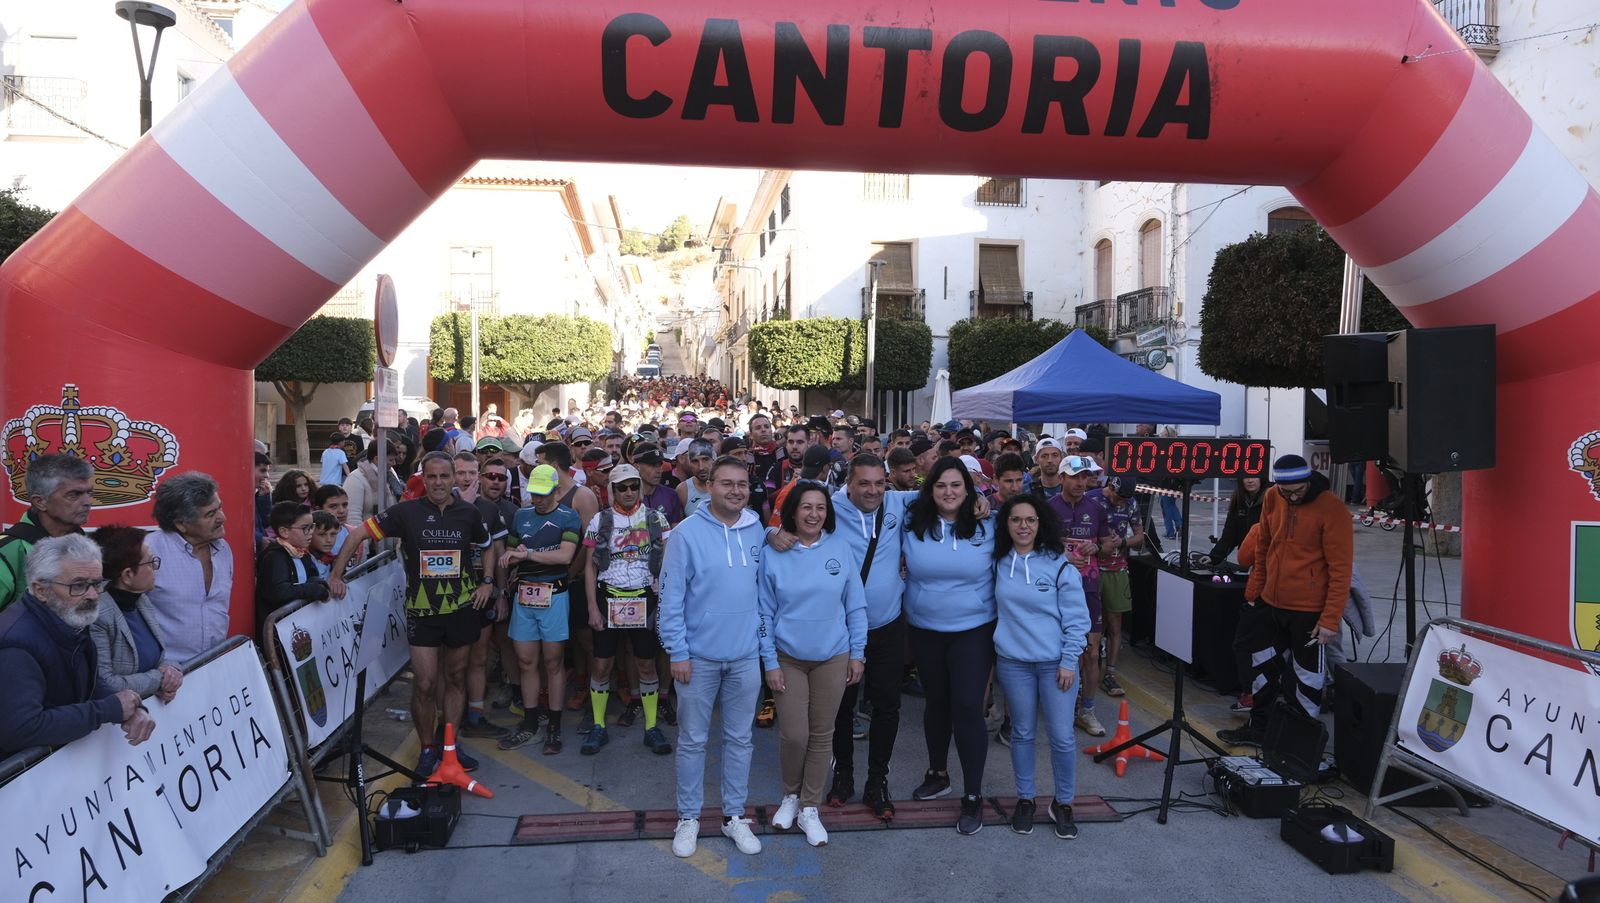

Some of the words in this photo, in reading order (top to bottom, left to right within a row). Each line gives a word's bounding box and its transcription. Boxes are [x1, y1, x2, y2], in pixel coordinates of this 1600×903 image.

[601, 12, 1212, 140] CANTORIA
[1112, 441, 1265, 475] 00:00:00
[422, 529, 462, 538] CUELLAR
[1071, 527, 1091, 536] TBM
[427, 556, 453, 567] 208
[526, 586, 541, 597] 31
[229, 686, 252, 716] DE
[1497, 687, 1600, 735] AYUN
